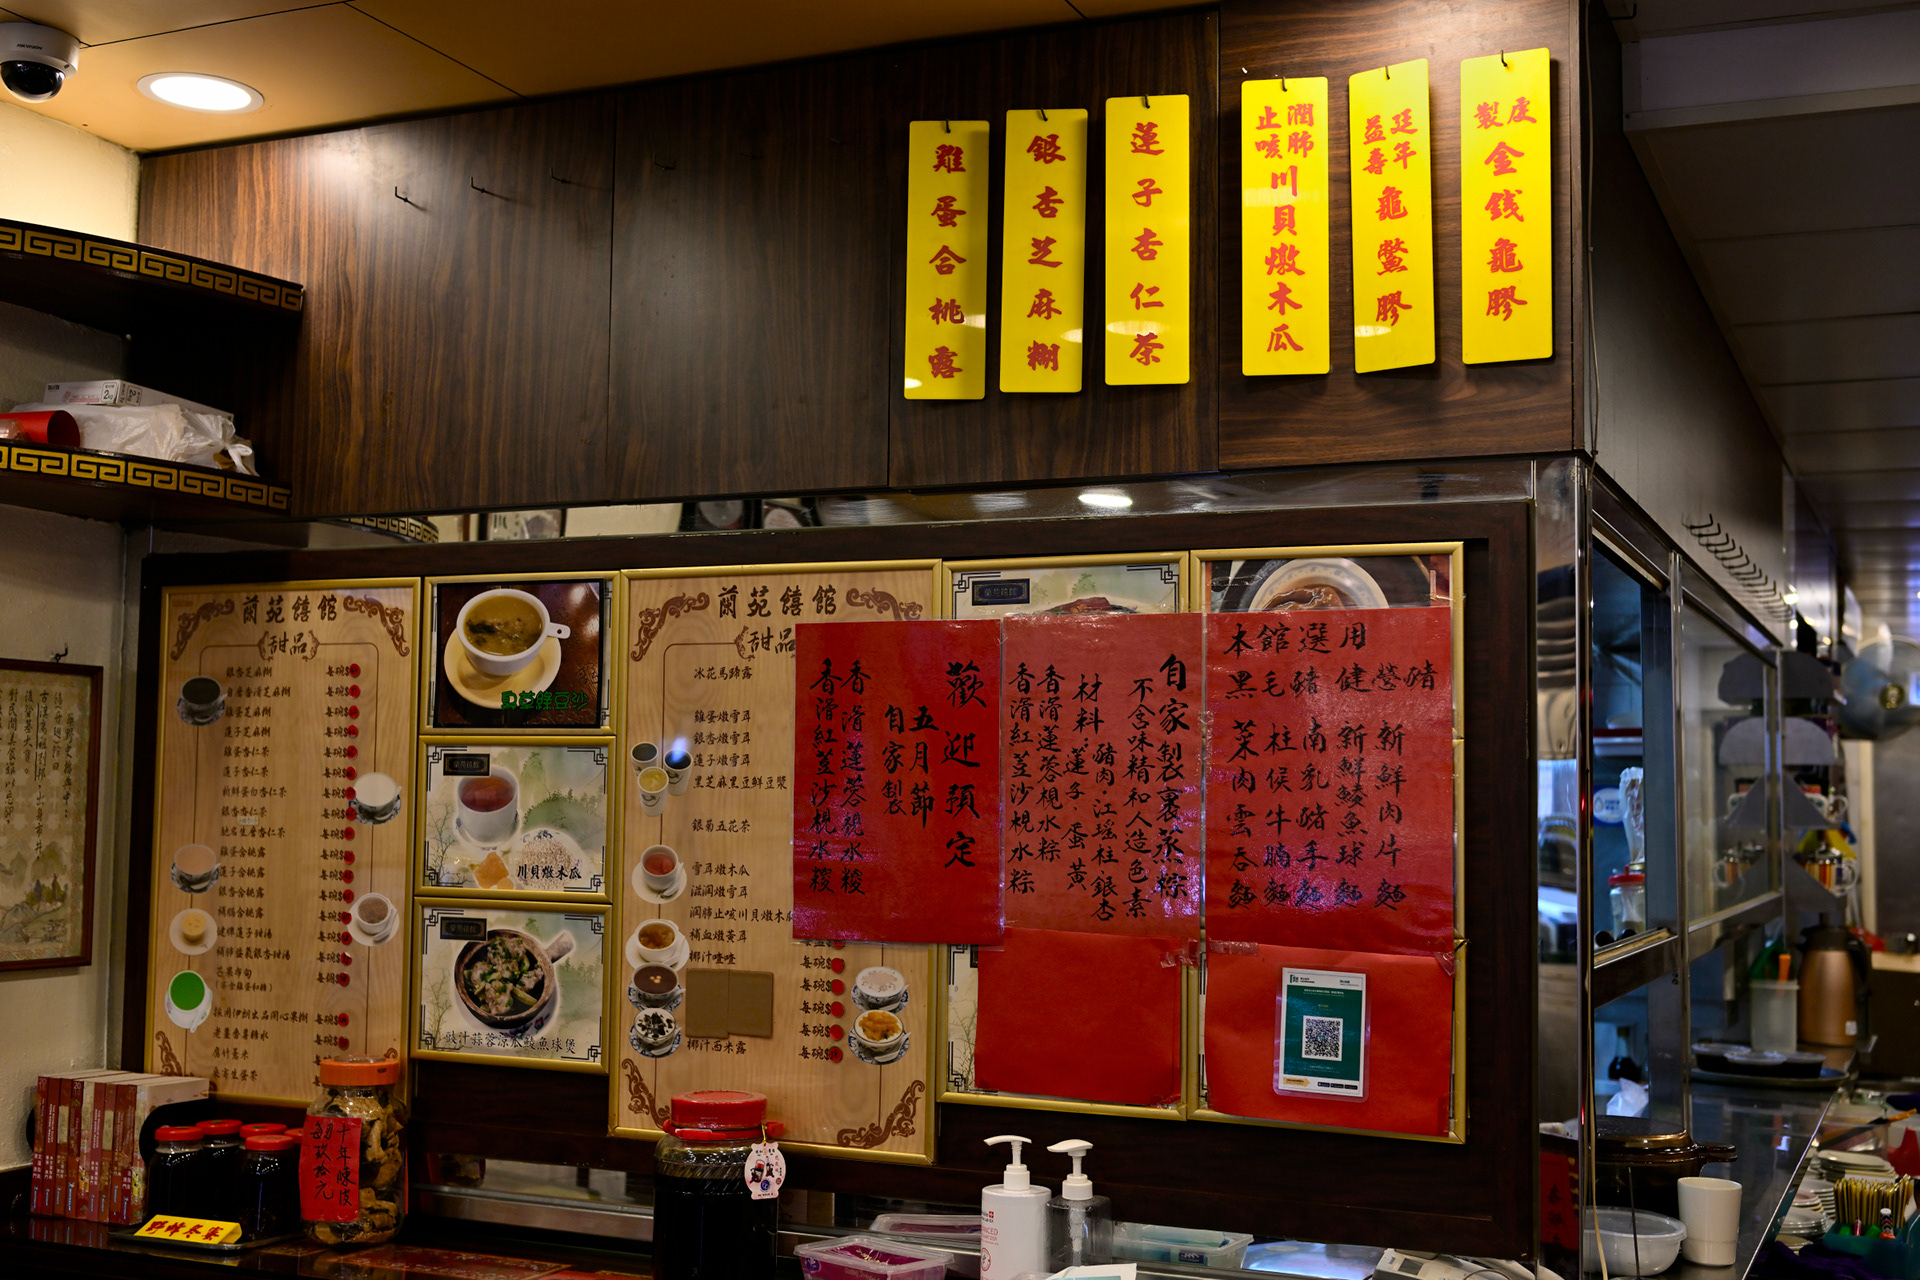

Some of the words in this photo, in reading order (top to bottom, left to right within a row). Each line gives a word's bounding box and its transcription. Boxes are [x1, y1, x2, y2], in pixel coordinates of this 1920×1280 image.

[1254, 105, 1284, 160] 止咳
[1286, 102, 1315, 159] 潤肺
[1362, 114, 1389, 175] 益壽
[1389, 107, 1419, 170] 延年
[927, 143, 968, 380] 雞蛋合桃露
[1026, 133, 1067, 372] 銀杏芝麻糊
[1129, 121, 1166, 367] 蓮子杏仁茶
[1264, 164, 1306, 352] 川貝燉木瓜
[1375, 185, 1413, 327] 龜鱉膠
[266, 631, 308, 657] 甜品
[747, 627, 795, 654] 甜品
[1223, 621, 1367, 659] 本館選用
[693, 666, 753, 680] 冰花馬蹄露
[1225, 665, 1322, 700] 黑毛豬
[693, 709, 751, 723] 雞蛋燉雪耳
[693, 731, 751, 745] 銀杏燉雪耳
[693, 753, 751, 768] 蓮子燉雪耳
[881, 704, 907, 816] 自家製
[908, 705, 939, 829] 五月節
[941, 660, 988, 868] 歡迎預定
[691, 818, 751, 833] 銀菊五花茶
[1226, 718, 1260, 910] 菜肉雲吞麵
[1294, 716, 1330, 911] 南乳豬手麵
[1334, 720, 1368, 909] 新鮮鯪魚球麵
[1374, 719, 1407, 910] 新鮮肉片麵
[516, 863, 583, 881] 川貝燉木瓜
[690, 861, 750, 877] 雪耳燉木瓜
[686, 1038, 747, 1055] 椰汁西米露
